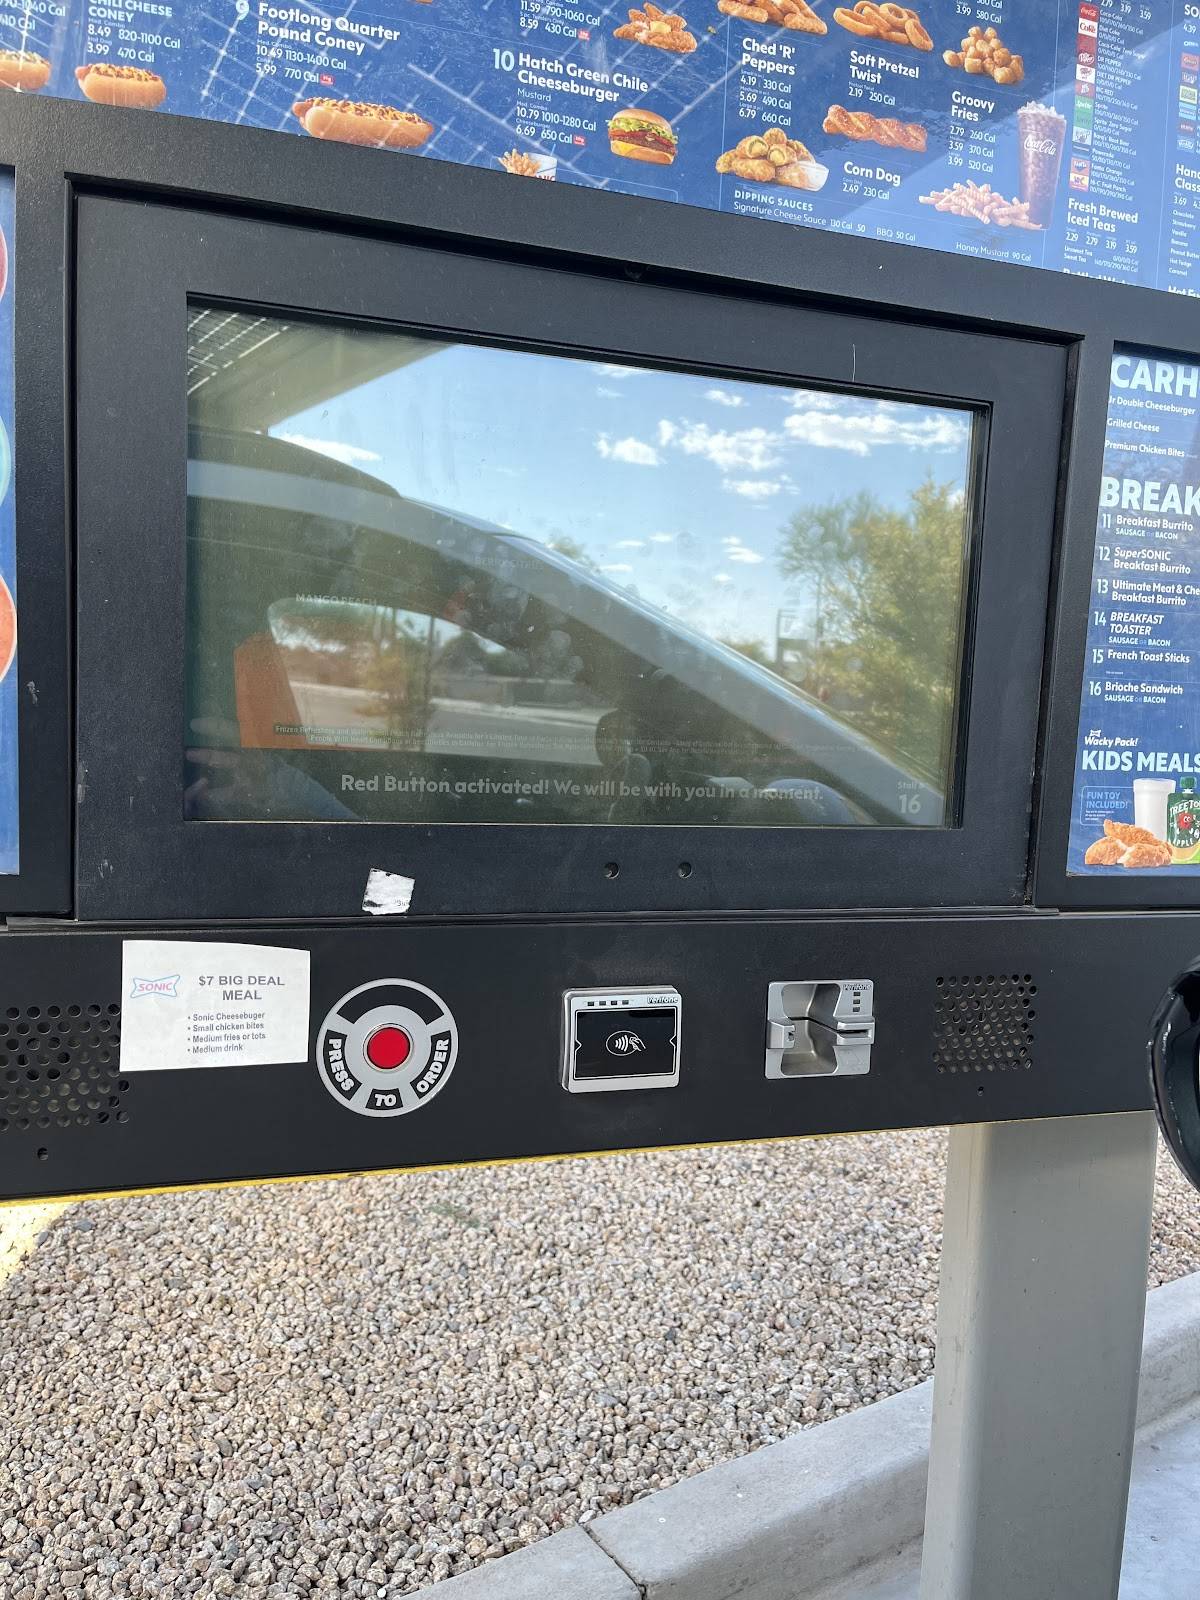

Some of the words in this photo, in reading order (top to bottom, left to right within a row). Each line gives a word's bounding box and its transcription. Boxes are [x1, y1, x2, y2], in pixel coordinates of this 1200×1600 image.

[89, 6, 134, 23] CONEY
[236, 0, 250, 20] 9
[521, 1, 541, 13] 11.59
[546, 6, 585, 22] 790-1060
[956, 5, 972, 16] 3.99
[976, 10, 990, 21] 580
[1184, 4, 1200, 18] SO
[259, 3, 332, 31] Footlong
[335, 17, 401, 41] Quarter
[520, 18, 539, 29] 8.59
[545, 23, 563, 35] 430
[88, 25, 111, 37] 8.49
[119, 29, 161, 45] 820-1100
[258, 21, 311, 42] Pound
[315, 31, 366, 55] Coney
[88, 42, 110, 55] 3.99
[117, 47, 136, 61] 470
[257, 46, 284, 59] 10.49
[285, 50, 330, 67] 1130-1400
[743, 38, 776, 56] Ched
[780, 44, 796, 59] 'R'
[256, 63, 277, 75] 5.99
[284, 68, 301, 80] 770
[493, 48, 515, 72] 10
[519, 53, 563, 74] Hatch
[566, 63, 610, 84] Green
[613, 73, 649, 92] Chile
[742, 53, 796, 76] Peppers
[850, 51, 876, 68] Soft
[878, 57, 919, 79] Pretzel
[740, 74, 757, 86] 4.19
[763, 79, 778, 91] 330
[850, 65, 882, 84] Twist
[518, 70, 620, 102] Cheeseburger
[849, 86, 863, 98] 2.19
[869, 92, 883, 103] 250
[518, 88, 552, 102] Mustard
[740, 91, 757, 103] 5.69
[762, 96, 778, 107] 490
[952, 91, 995, 113] Groovy
[517, 107, 540, 120] 10.79
[542, 111, 581, 129] 1010-1280
[739, 108, 757, 119] 6.79
[762, 112, 778, 123] 660
[952, 106, 979, 122] Fries
[516, 125, 536, 137] 6.69
[541, 129, 558, 141] 650
[948, 156, 963, 167] 3.99
[844, 161, 873, 179] Corn
[876, 168, 901, 186] Dog
[843, 182, 859, 194] 2.49
[735, 191, 775, 205] DIPPING
[778, 198, 814, 212] SAUCES
[734, 201, 773, 217] Signature
[774, 208, 802, 220] Cheese
[804, 213, 826, 226] Sauce
[876, 228, 894, 237] BBQ
[1068, 198, 1097, 215] Fresh
[1099, 204, 1139, 224] Brewed
[1068, 212, 1090, 227] Iced
[1092, 218, 1116, 232] Teas
[1117, 397, 1144, 408] Double
[1145, 401, 1196, 416] Cheeseburger
[1107, 418, 1132, 428] Grilled
[1134, 421, 1160, 432] Cheese
[1105, 440, 1138, 452] Premium
[1139, 444, 1167, 456] Chicken
[1168, 448, 1185, 458] Bites
[1100, 476, 1200, 517] BREAK
[1102, 514, 1111, 529] 11
[1117, 515, 1160, 526] Breakfast
[1163, 520, 1193, 531] Burrito
[1116, 528, 1146, 537] SAUSAGE
[1156, 531, 1178, 540] BACON
[1099, 546, 1110, 561] 12
[1115, 547, 1172, 561] SuperSONIC
[1114, 559, 1158, 572] Breakfast
[1160, 564, 1191, 575] Burrito
[1097, 579, 1109, 594] 13
[1113, 580, 1153, 591] Ultimate
[1153, 583, 1176, 593] Meat
[1177, 585, 1183, 593] &
[1112, 592, 1155, 603] Breakfast
[1157, 596, 1187, 606] Burrito
[1094, 611, 1107, 626] 14
[1110, 612, 1165, 624] BREAKFAST
[1110, 623, 1152, 636] TOASTER
[1108, 636, 1138, 645] SAUSAGE
[1148, 639, 1171, 647] BACON
[1093, 649, 1104, 664] 15
[1108, 650, 1138, 660] French
[1140, 651, 1164, 661] Toast
[1165, 653, 1190, 664] Sticks
[1090, 681, 1102, 696] 16
[1105, 682, 1139, 693] Brioche
[1140, 683, 1184, 695] Sandwich
[1104, 694, 1134, 703] SAUSAGE
[1143, 696, 1166, 704] BACON
[1085, 736, 1114, 748] Wacky
[1115, 737, 1139, 747] Pack!
[1082, 750, 1133, 772] KIDS
[341, 774, 379, 791] Red
[385, 776, 450, 793] Button
[455, 778, 549, 795] activated!
[554, 780, 581, 797] We
[584, 780, 616, 797] will
[620, 781, 640, 798] be
[644, 782, 682, 799] with
[685, 786, 716, 802] you
[720, 783, 734, 799] in
[752, 785, 823, 801] moment.
[1087, 792, 1104, 800] FUN
[1105, 792, 1121, 800] TOY
[899, 794, 921, 814] 16
[1086, 801, 1129, 809] INCLUDED!
[1170, 802, 1188, 818] TREE
[138, 982, 172, 992] SONIC
[198, 976, 214, 986] $7
[218, 975, 243, 986] BIG
[248, 976, 286, 986] DEAL
[222, 990, 262, 1001] MEAL
[193, 1013, 215, 1022] Sonic
[216, 1012, 266, 1023] Cheesebuger
[193, 1024, 214, 1032] Small
[215, 1023, 245, 1032] chicken
[246, 1022, 264, 1030] bites
[193, 1035, 222, 1044] Medium
[223, 1034, 241, 1042] fries
[251, 1032, 266, 1040] tots
[193, 1046, 222, 1054] Medium
[223, 1044, 243, 1052] drink
[328, 1038, 355, 1092] PRESS
[374, 1094, 397, 1107] TO
[416, 1038, 450, 1093] ORDER
